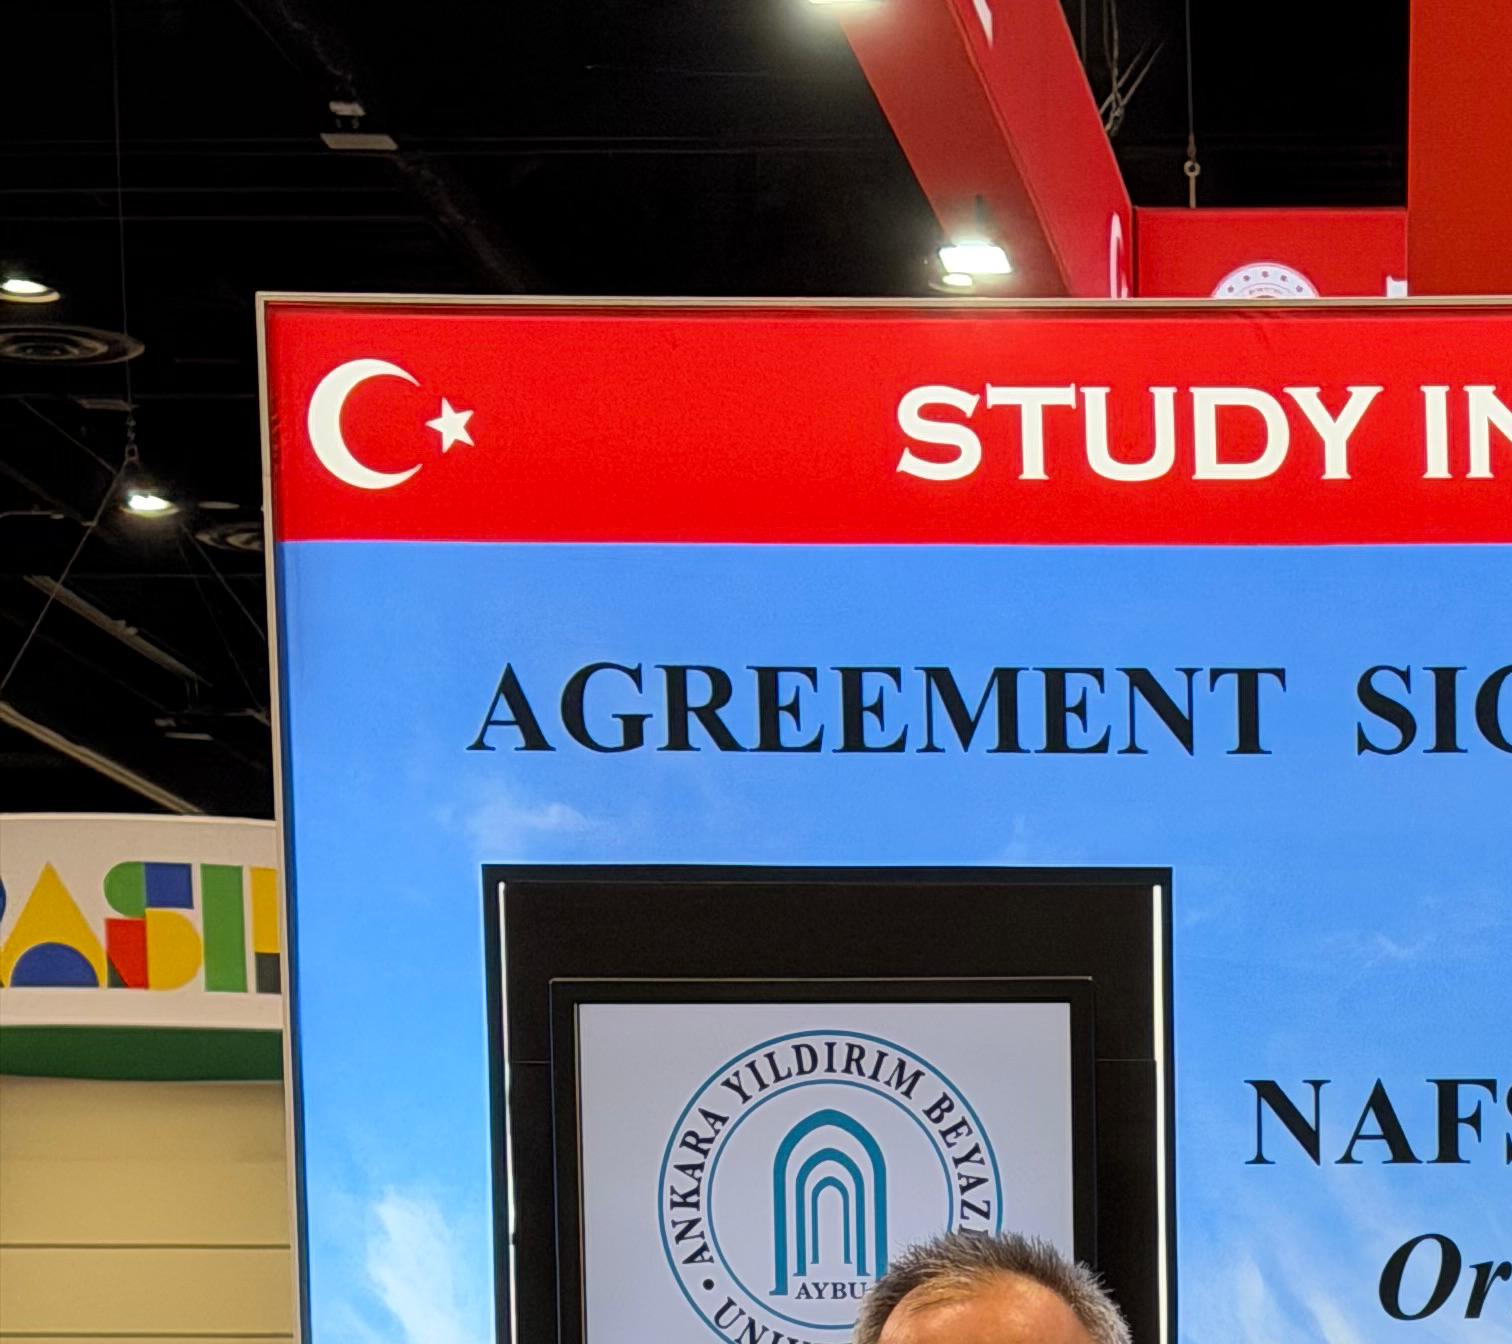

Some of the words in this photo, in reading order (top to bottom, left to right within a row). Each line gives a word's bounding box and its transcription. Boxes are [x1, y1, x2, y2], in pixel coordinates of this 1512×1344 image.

[896, 382, 1384, 482] STUDY
[466, 661, 1285, 756] AGREEMENT
[671, 1108, 730, 1265] ANKARA
[721, 1042, 925, 1104] YILDIRIM
[795, 1282, 866, 1300] AYBU
